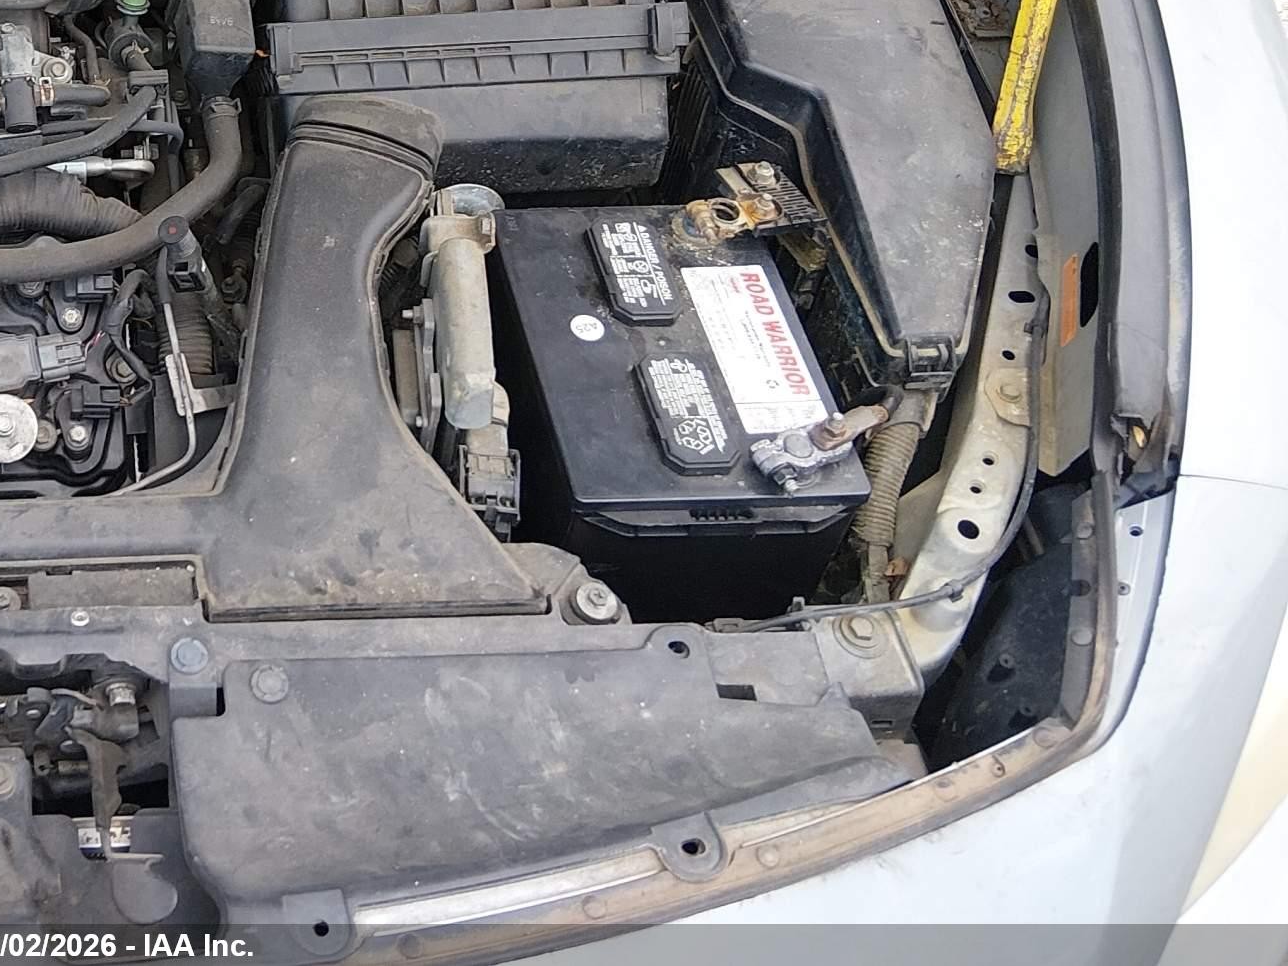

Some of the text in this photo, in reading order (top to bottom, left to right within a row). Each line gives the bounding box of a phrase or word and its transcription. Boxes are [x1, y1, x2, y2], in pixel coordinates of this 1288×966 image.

[641, 232, 660, 264] DANGER
[654, 270, 673, 300] POISON
[739, 272, 774, 315] ROAD
[762, 320, 810, 395] WARRIOR
